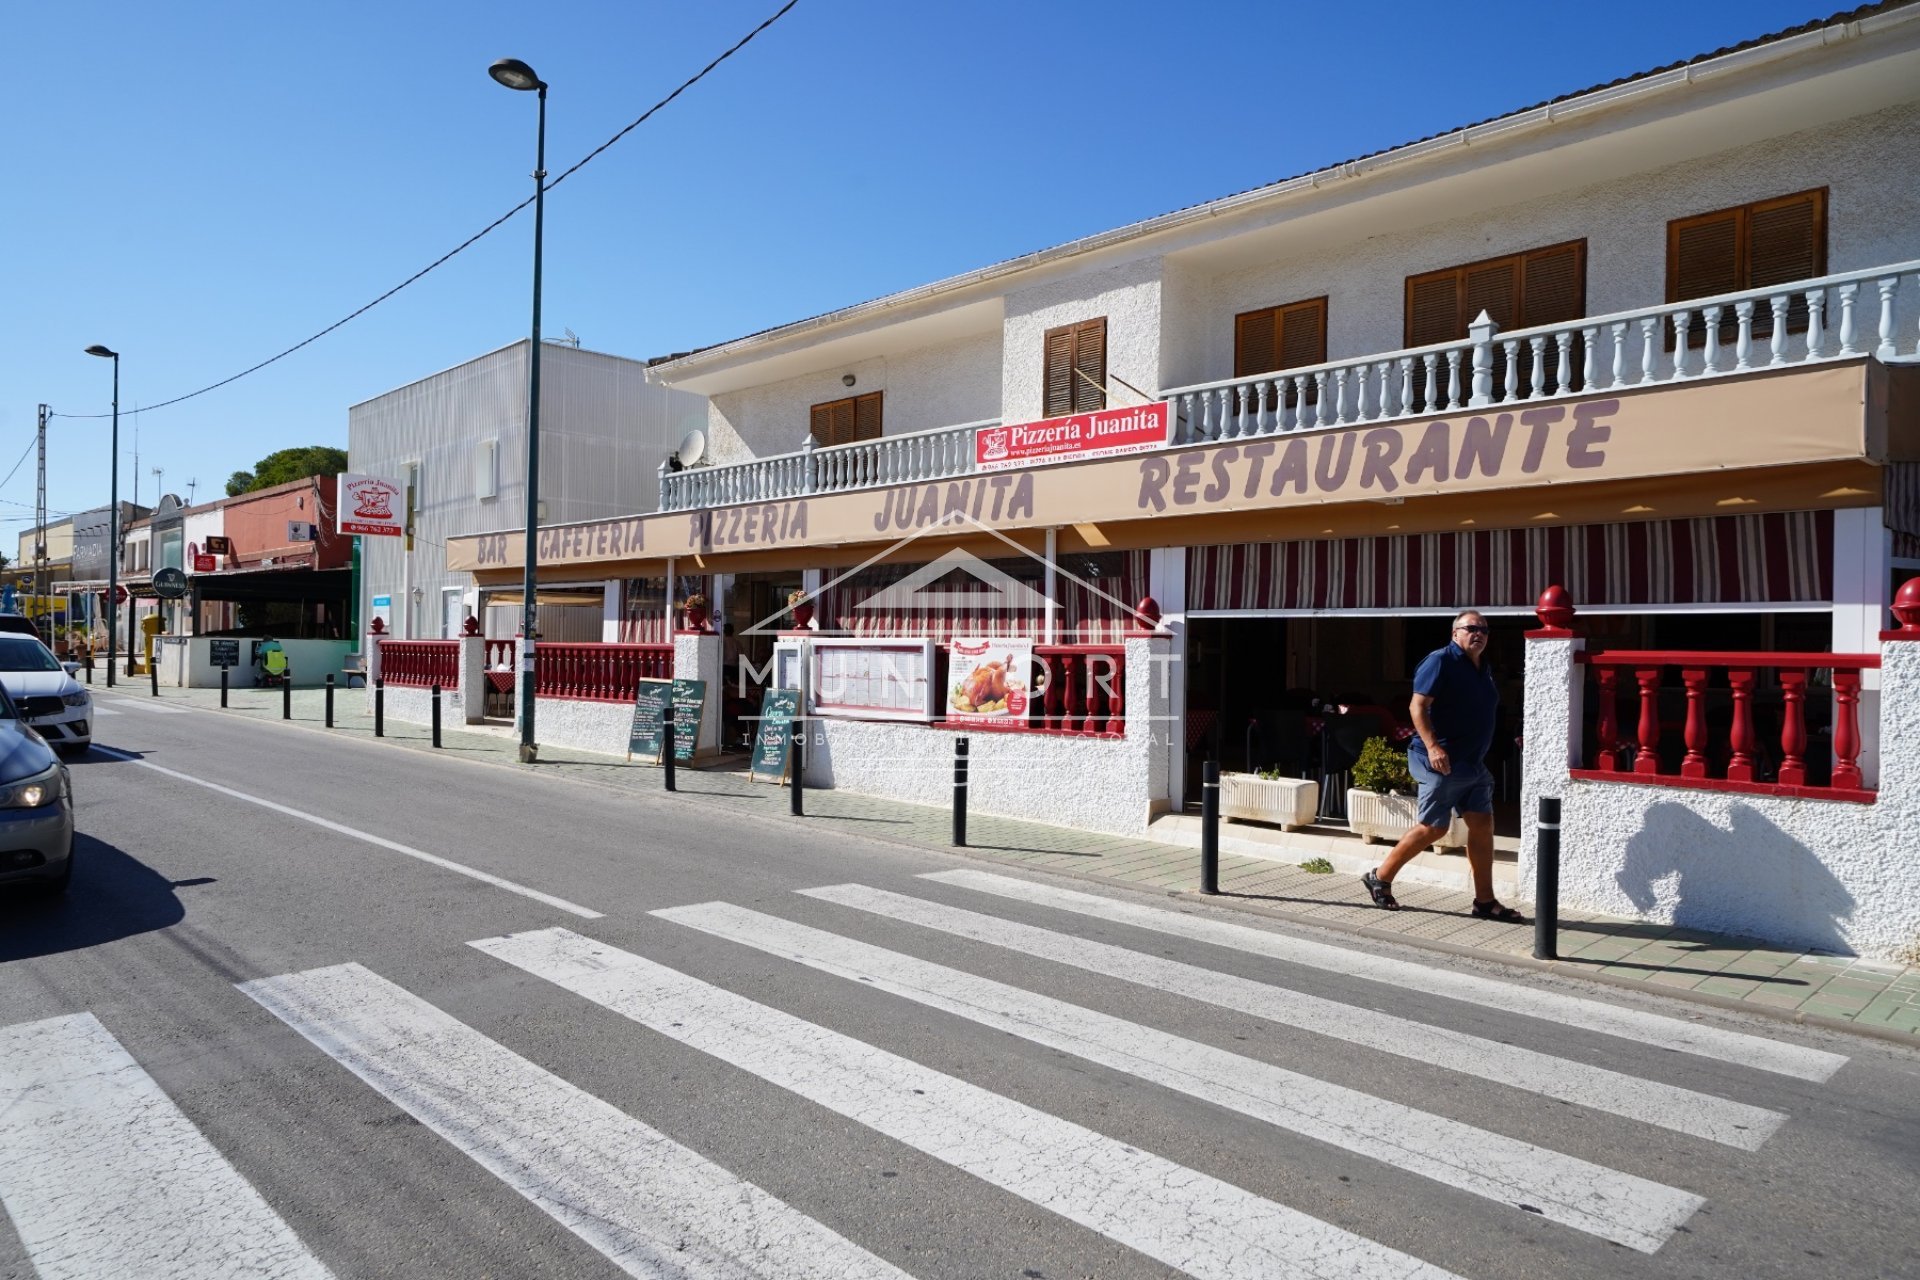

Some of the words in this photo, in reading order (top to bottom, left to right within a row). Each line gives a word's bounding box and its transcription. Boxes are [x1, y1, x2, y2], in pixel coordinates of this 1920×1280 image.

[1011, 418, 1081, 447] Pizzería
[1085, 409, 1159, 440] Juanita
[1010, 442, 1081, 457] www.pizzeriajuanita.es
[477, 535, 508, 565] BAR
[539, 519, 645, 561] CAFETERIA
[688, 500, 809, 548] PIZZERIA
[874, 473, 1034, 533] JUANITA
[1138, 398, 1620, 513] RESTAURANTE
